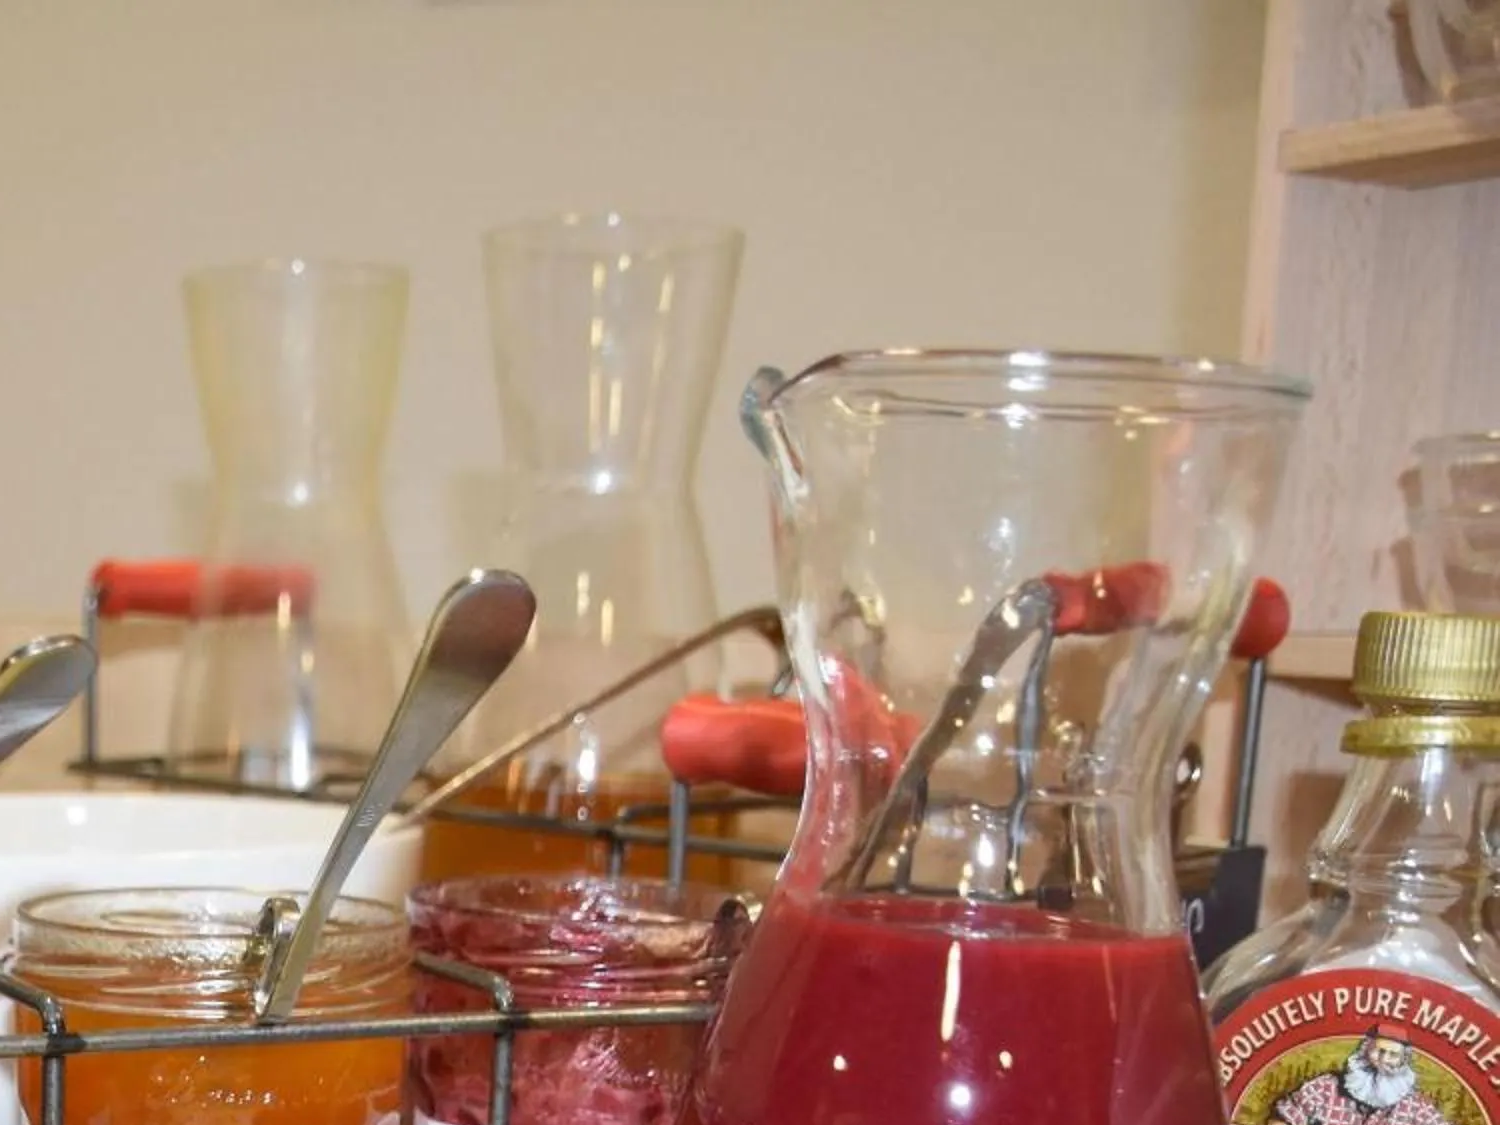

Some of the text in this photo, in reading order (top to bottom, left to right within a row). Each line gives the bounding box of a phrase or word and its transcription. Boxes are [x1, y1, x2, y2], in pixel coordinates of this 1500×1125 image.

[1218, 986, 1500, 1087] BSOLUTELY PURE MAPLE
